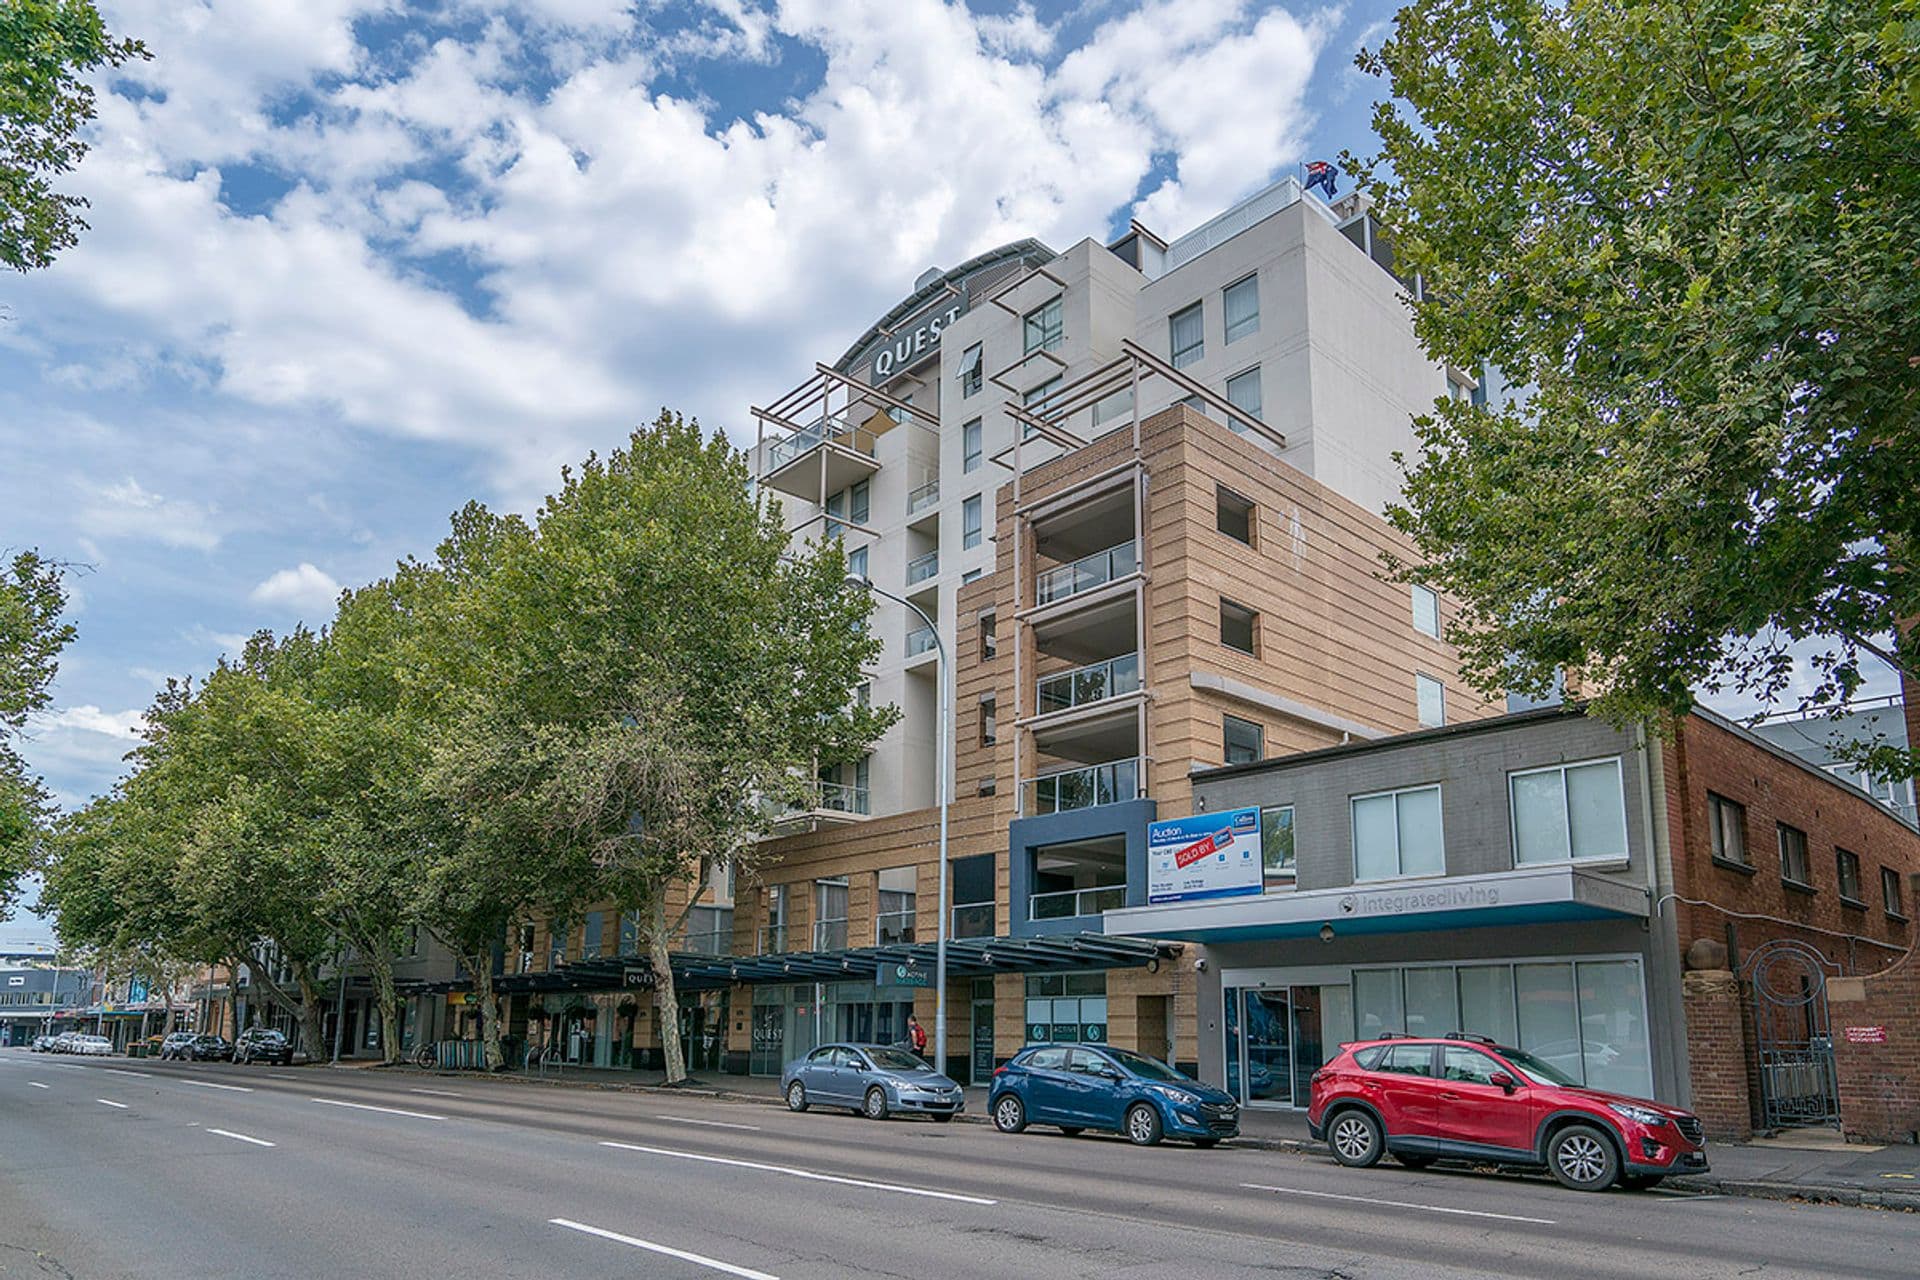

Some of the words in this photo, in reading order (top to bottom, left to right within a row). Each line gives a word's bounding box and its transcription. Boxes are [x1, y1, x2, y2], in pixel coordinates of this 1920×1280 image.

[876, 306, 960, 376] QUEST
[1152, 827, 1182, 838] Auction
[1178, 847, 1199, 865] SOLD
[1198, 841, 1212, 854] BY
[753, 1028, 783, 1041] QUEST
